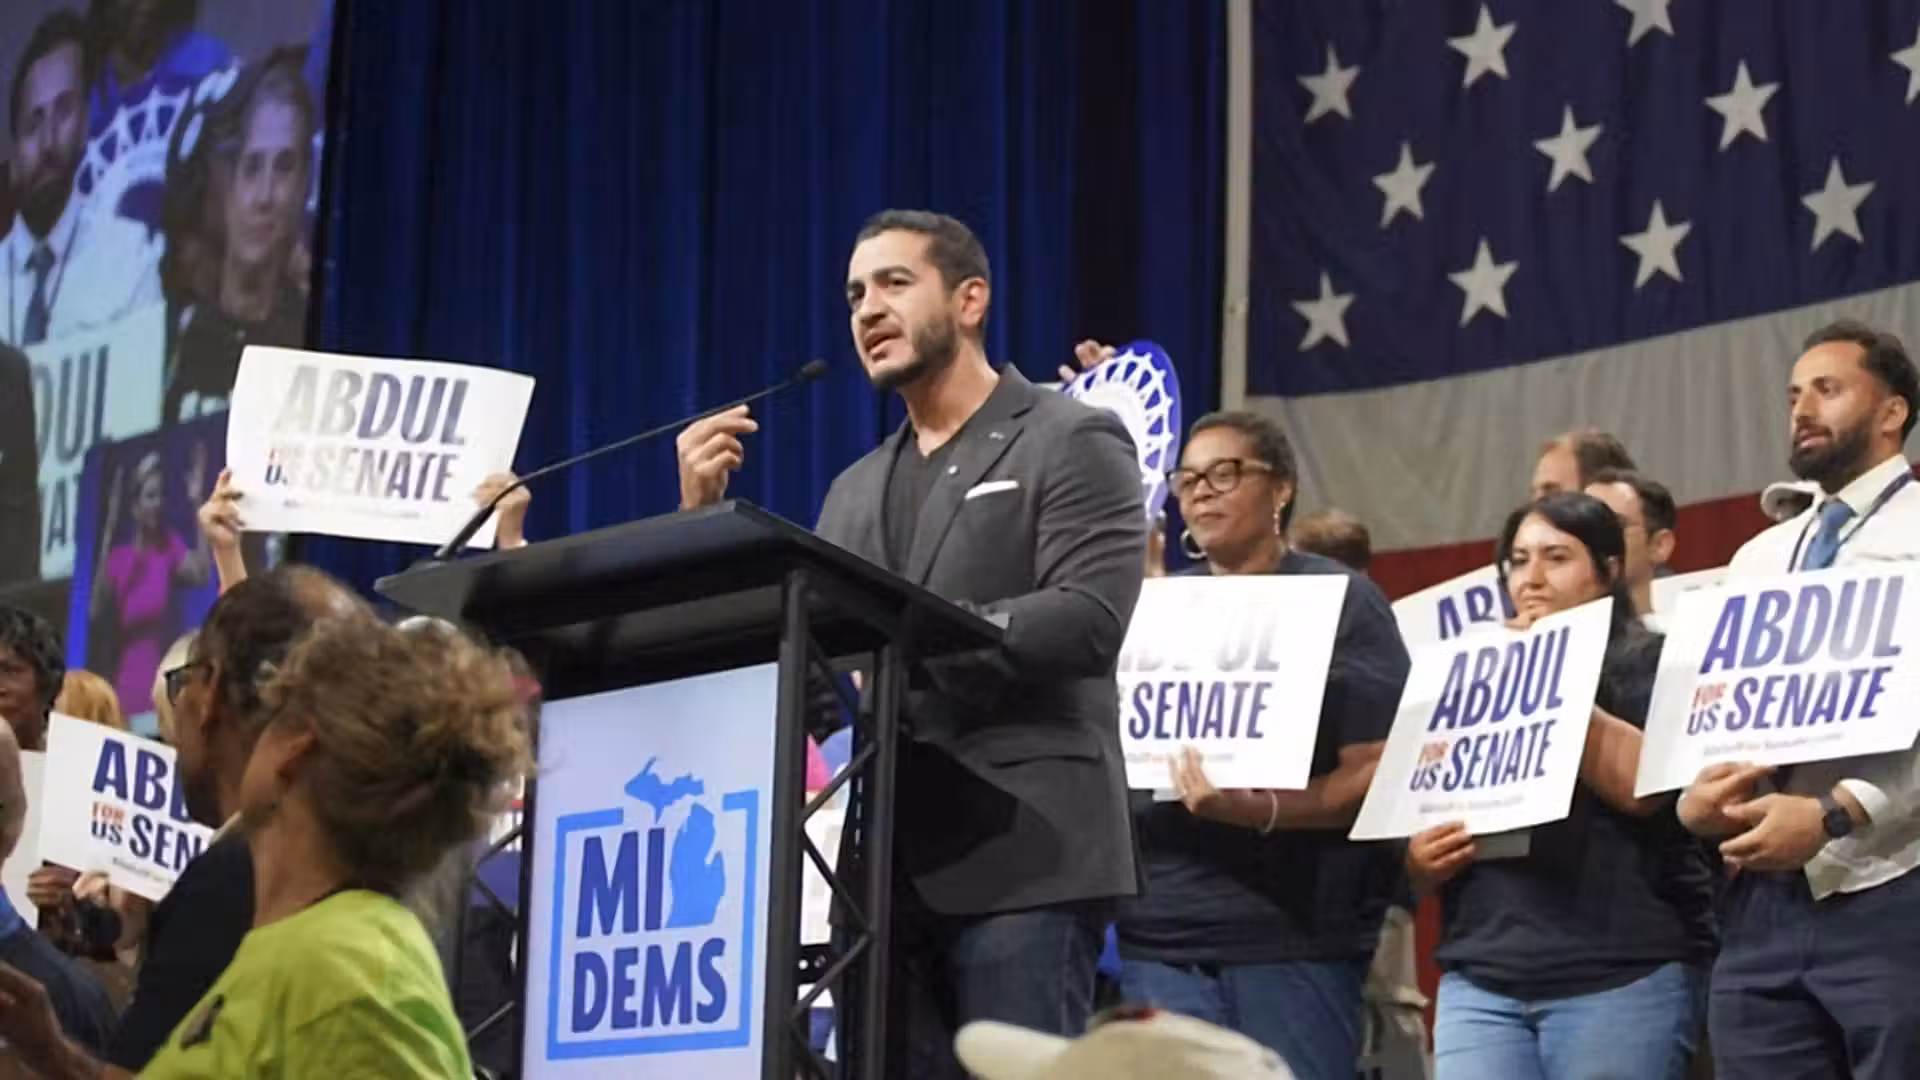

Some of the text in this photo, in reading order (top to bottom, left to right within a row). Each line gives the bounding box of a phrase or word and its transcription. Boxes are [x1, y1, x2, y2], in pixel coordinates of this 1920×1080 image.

[272, 364, 470, 445] ABDUL
[304, 446, 461, 502] SENATE
[1698, 575, 1904, 675] ABDUL
[1128, 680, 1272, 740] SENATE
[1427, 625, 1570, 732] ABDUL
[1687, 665, 1893, 736] US SENATE
[1409, 719, 1557, 793] US SENATE
[91, 820, 123, 846] US
[92, 801, 124, 822] FOR
[576, 827, 665, 938] MI
[571, 937, 727, 1034] DEMS
